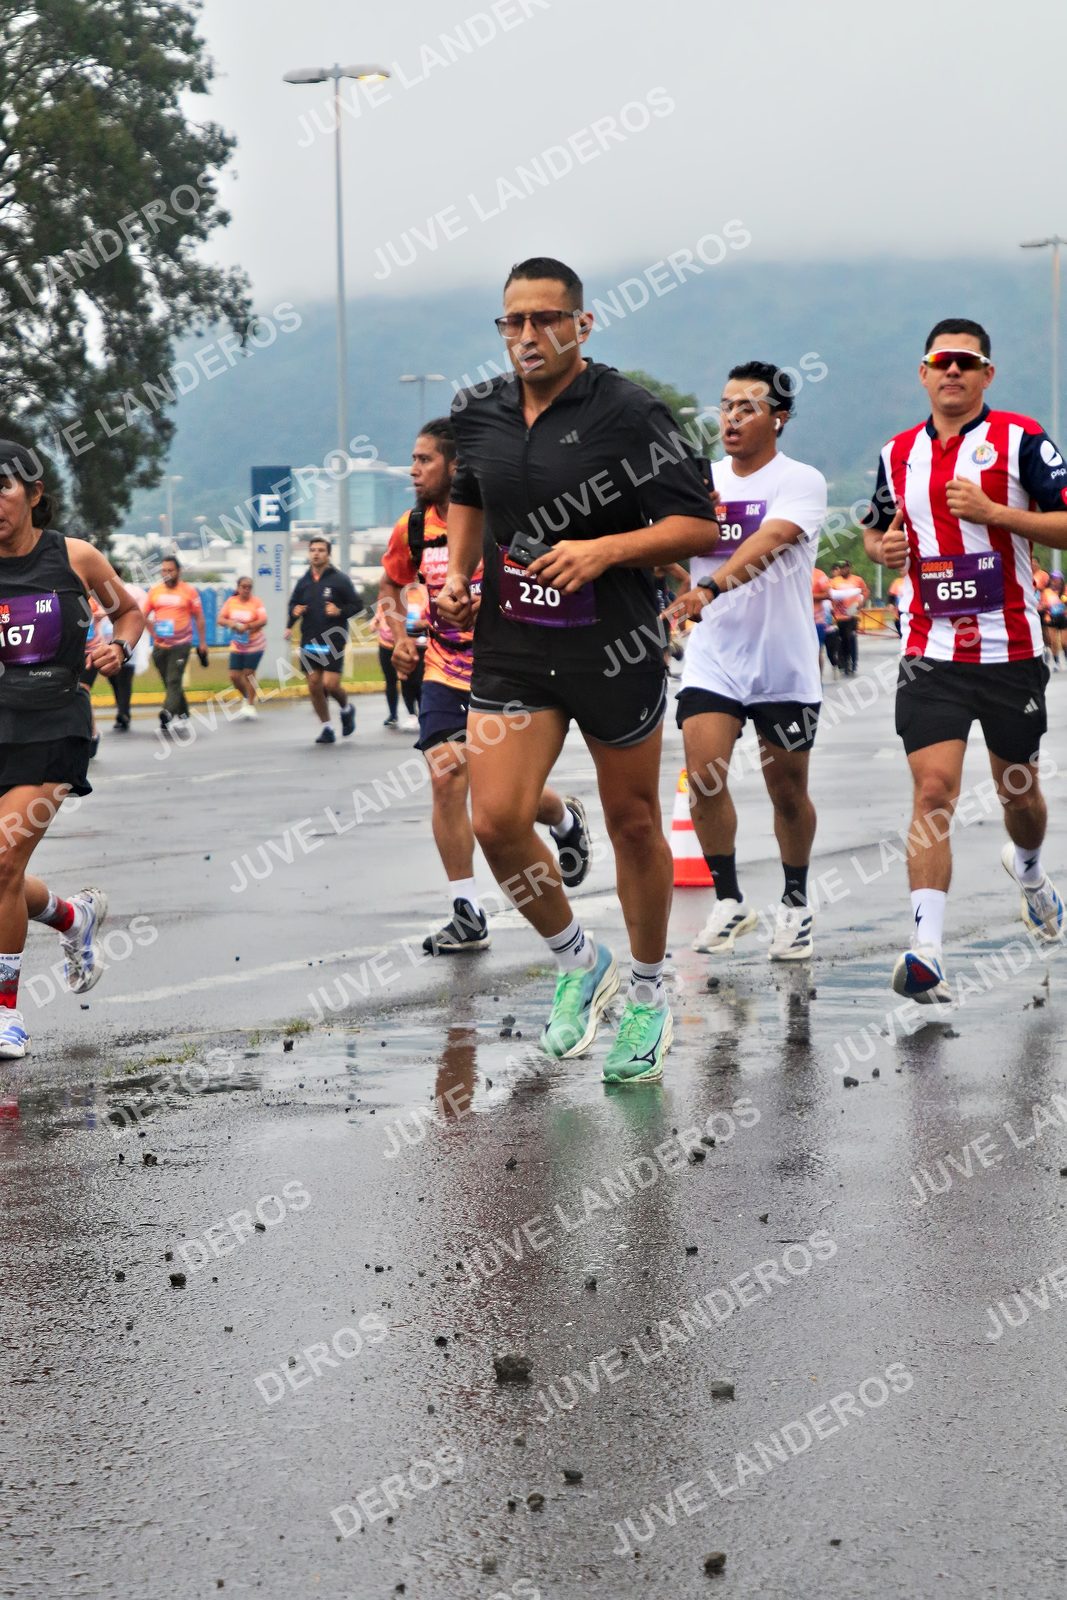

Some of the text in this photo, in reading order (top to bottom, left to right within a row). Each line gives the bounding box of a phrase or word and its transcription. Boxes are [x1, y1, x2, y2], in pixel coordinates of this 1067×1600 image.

[259, 494, 281, 524] E
[719, 523, 742, 541] 30
[519, 582, 561, 608] 220
[936, 579, 978, 601] 655
[35, 599, 53, 614] 15K
